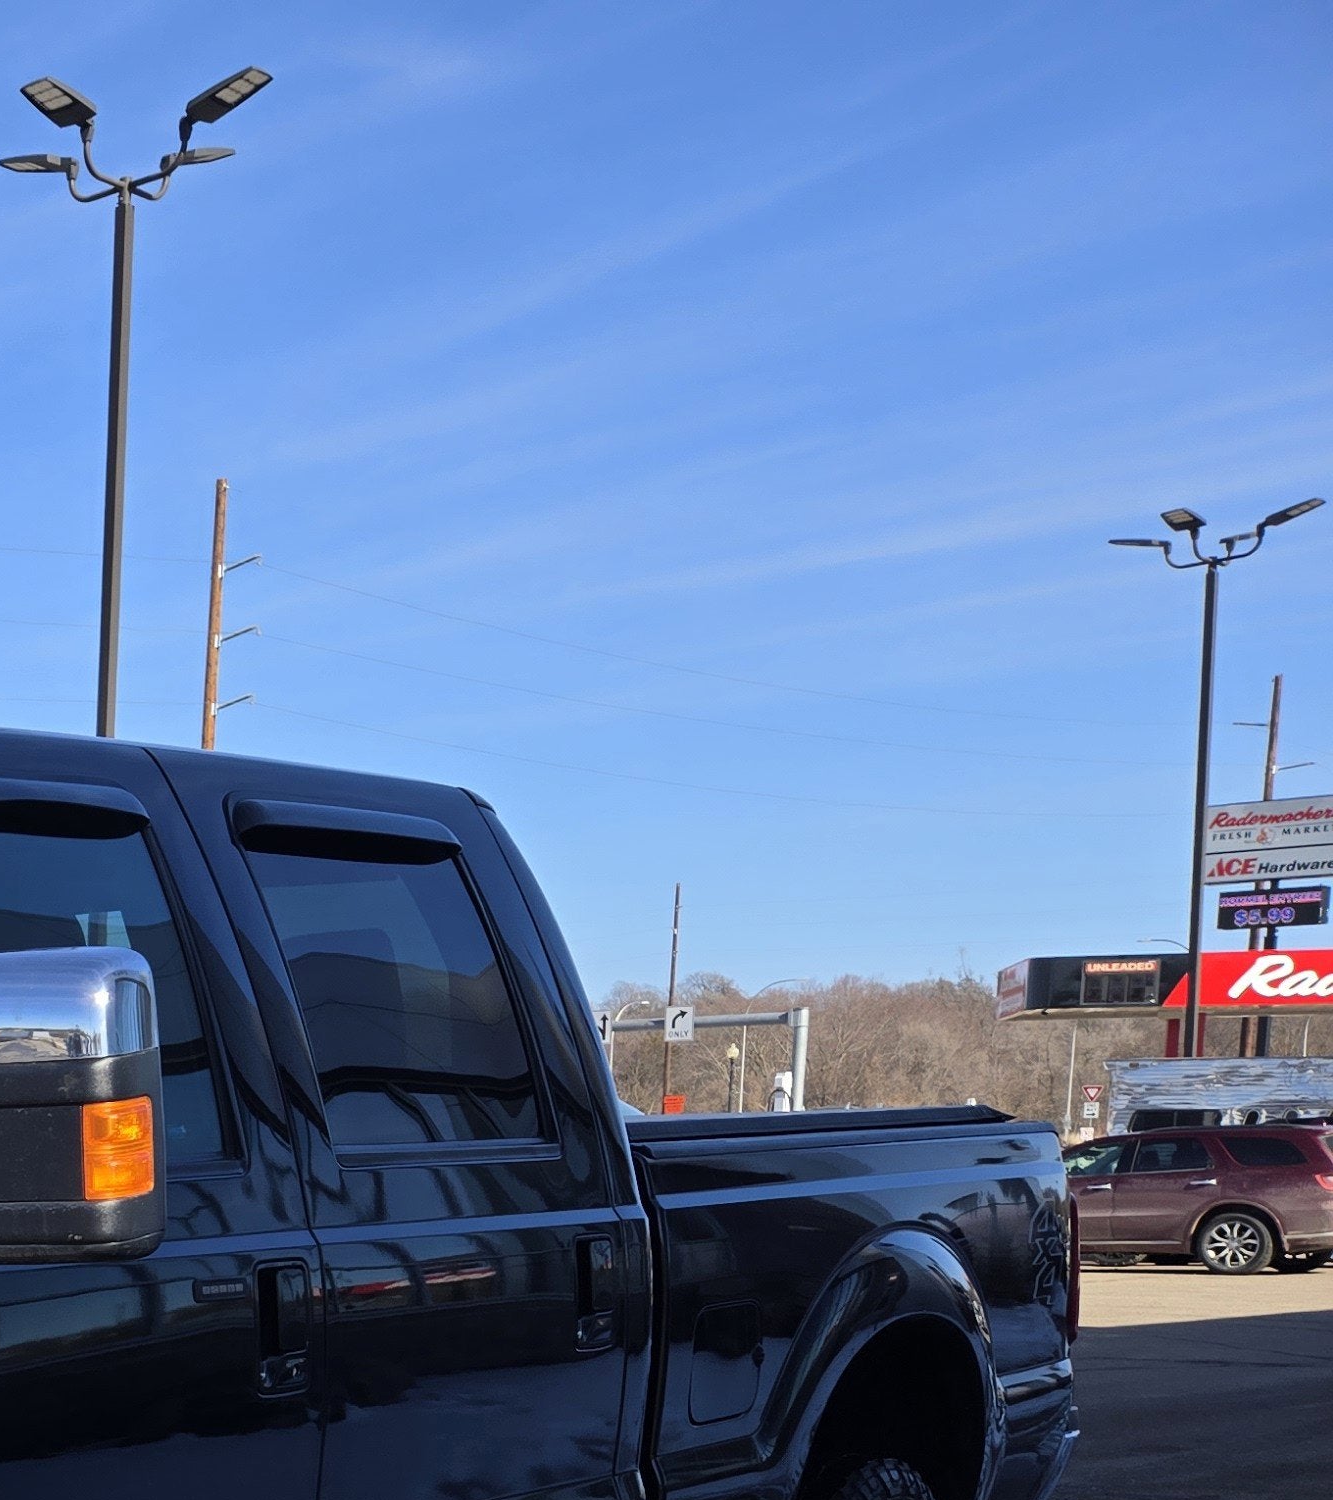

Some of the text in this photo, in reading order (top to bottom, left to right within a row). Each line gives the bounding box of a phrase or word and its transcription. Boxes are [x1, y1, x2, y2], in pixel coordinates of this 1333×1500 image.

[1213, 824, 1333, 841] FRESH MARKE
[1207, 857, 1333, 878] ACE Hardware
[1087, 960, 1158, 974] UNLEADED
[668, 1030, 689, 1039] ONLY
